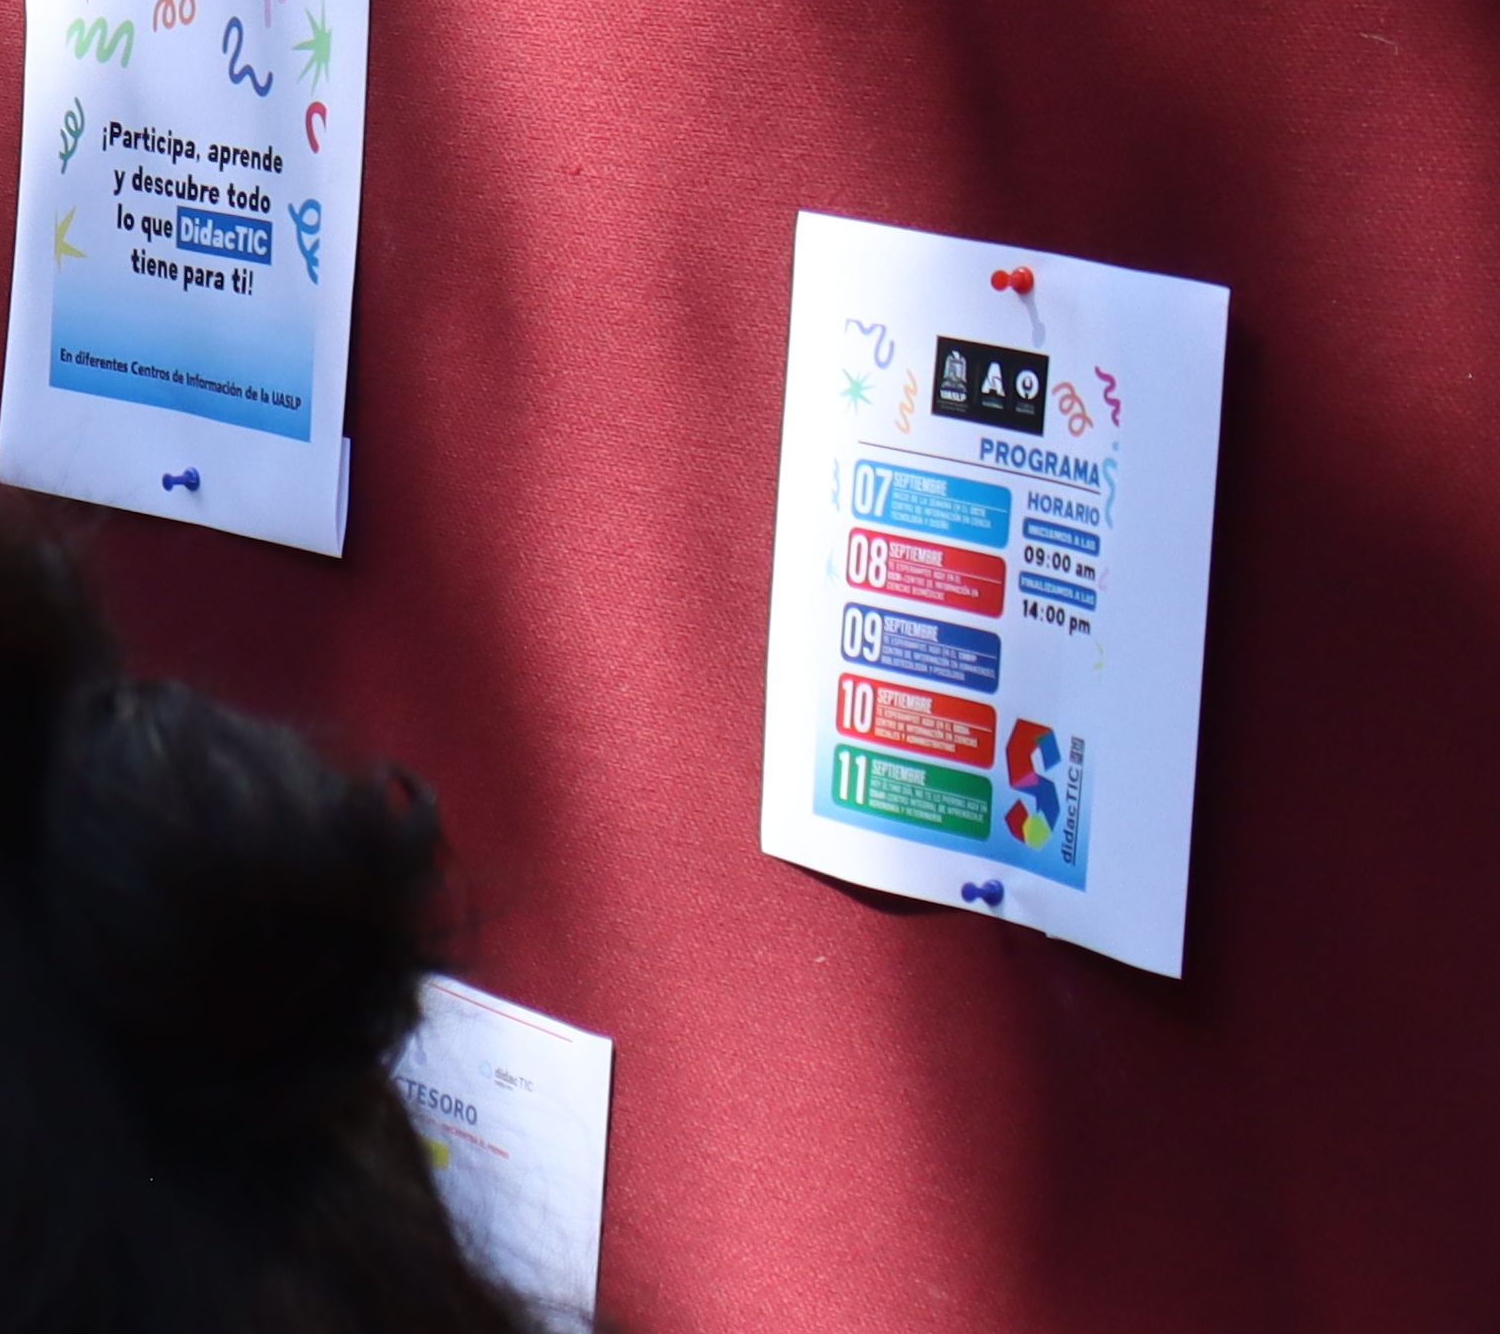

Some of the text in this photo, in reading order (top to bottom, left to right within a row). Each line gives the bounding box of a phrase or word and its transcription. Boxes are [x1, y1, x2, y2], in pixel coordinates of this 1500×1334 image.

[102, 121, 283, 174] ¡Participa, aprende
[113, 165, 271, 214] y descubre todo
[117, 203, 268, 256] lo que DidacTIC
[131, 248, 254, 296] tiene para ti!
[60, 348, 302, 410] En diferentes Centros de Información de la UASLP
[979, 437, 1100, 489] PROGRAMA
[854, 463, 948, 517] 07 SEPTIEMBRE
[1027, 490, 1100, 527] HORARIO
[849, 533, 943, 589] 08 SEPTIEMBRE
[1024, 545, 1096, 581] 09:00 am
[843, 607, 938, 663] 09 SEPTIEMBRE
[1023, 599, 1091, 636] 14:00 pm
[842, 679, 933, 733] 10 SEPTIEMBRE
[838, 749, 926, 805] 11 SEPTIEMBRE
[1061, 767, 1080, 864] didacTIC
